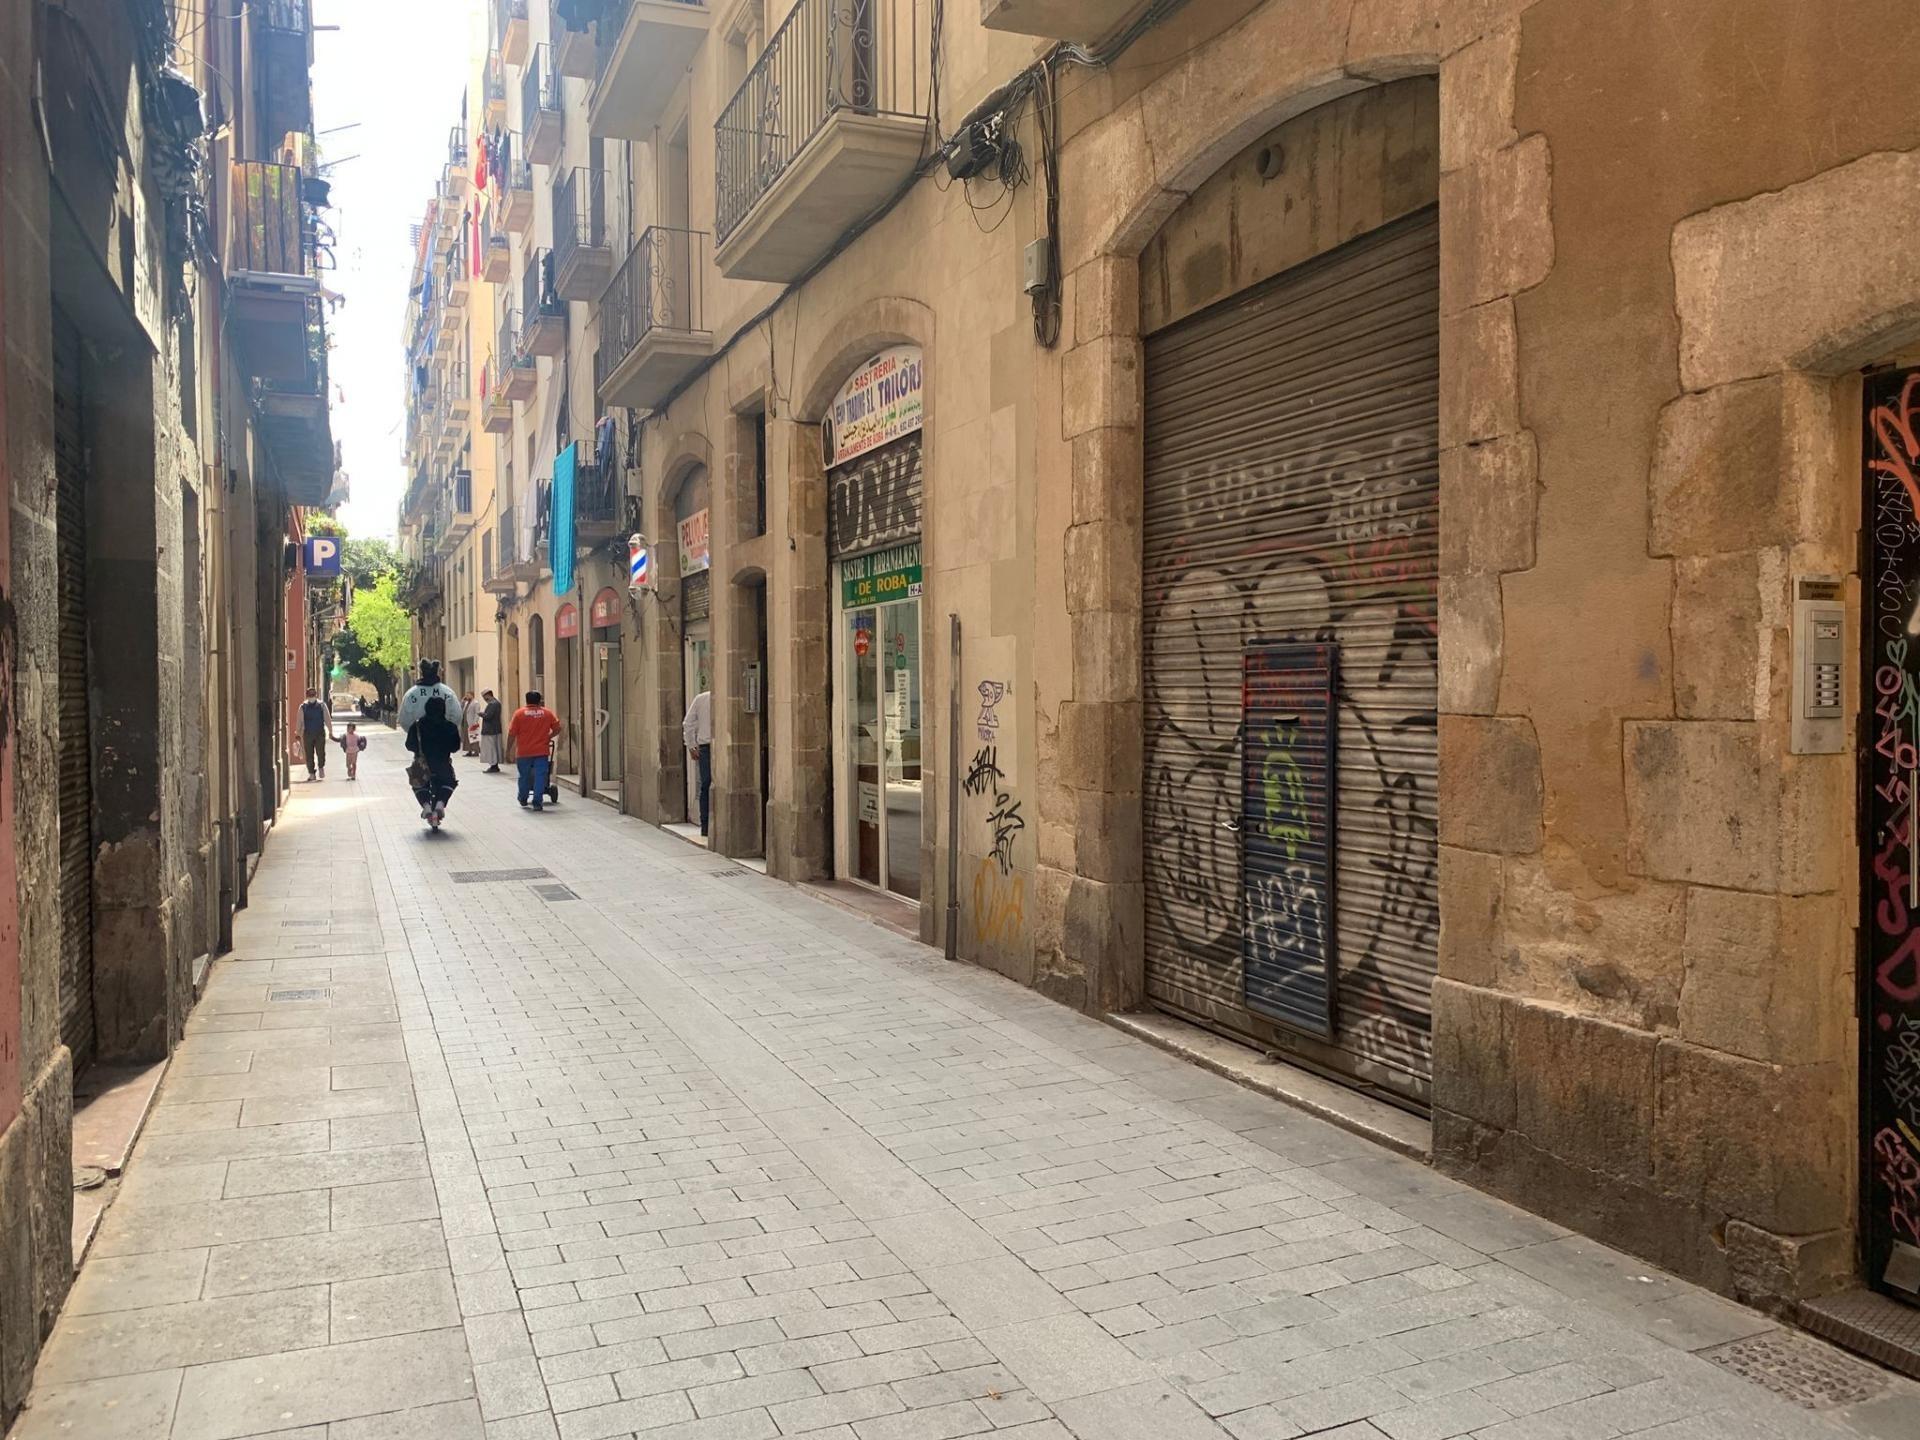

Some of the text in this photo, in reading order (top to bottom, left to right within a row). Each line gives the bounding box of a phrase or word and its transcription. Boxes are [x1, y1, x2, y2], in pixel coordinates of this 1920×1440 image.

[854, 355, 897, 391] SASTRERIA
[878, 359, 922, 407] TAILORS
[313, 539, 336, 567] P
[843, 557, 865, 582] SASTRE
[858, 574, 908, 596] DE ROBA
